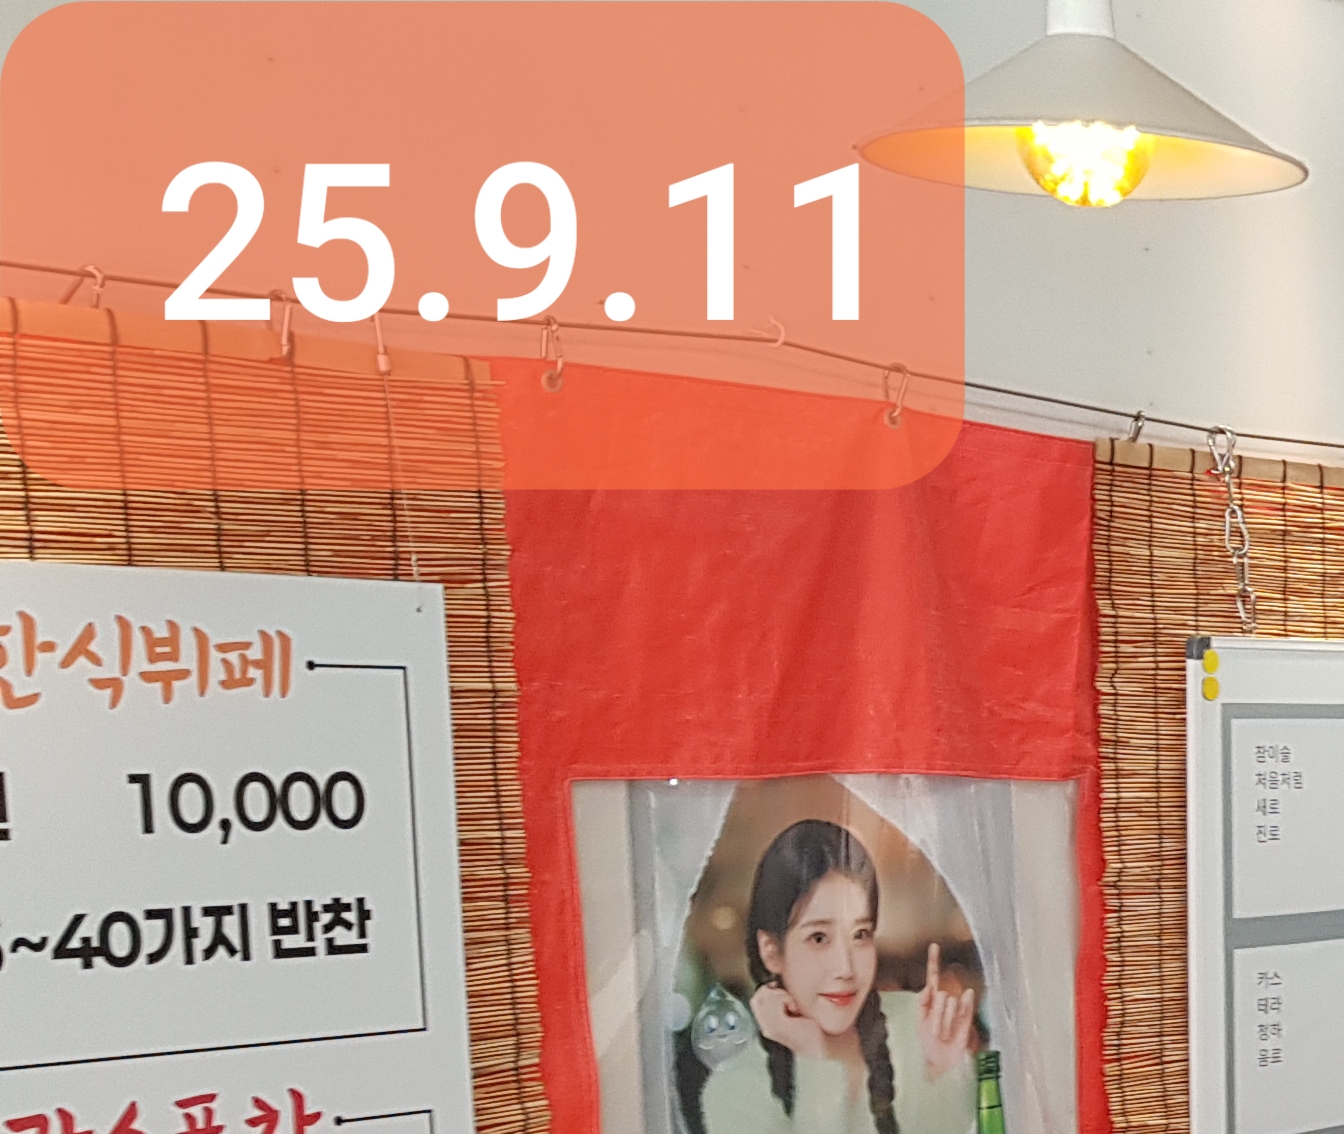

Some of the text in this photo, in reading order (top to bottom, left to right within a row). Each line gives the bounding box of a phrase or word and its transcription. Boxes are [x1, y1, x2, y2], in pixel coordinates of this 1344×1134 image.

[1255, 745, 1292, 764] 참이슬
[128, 771, 365, 844] 10,000
[0, 898, 371, 969] ~40가지 반찬
[1257, 971, 1283, 988] 카스
